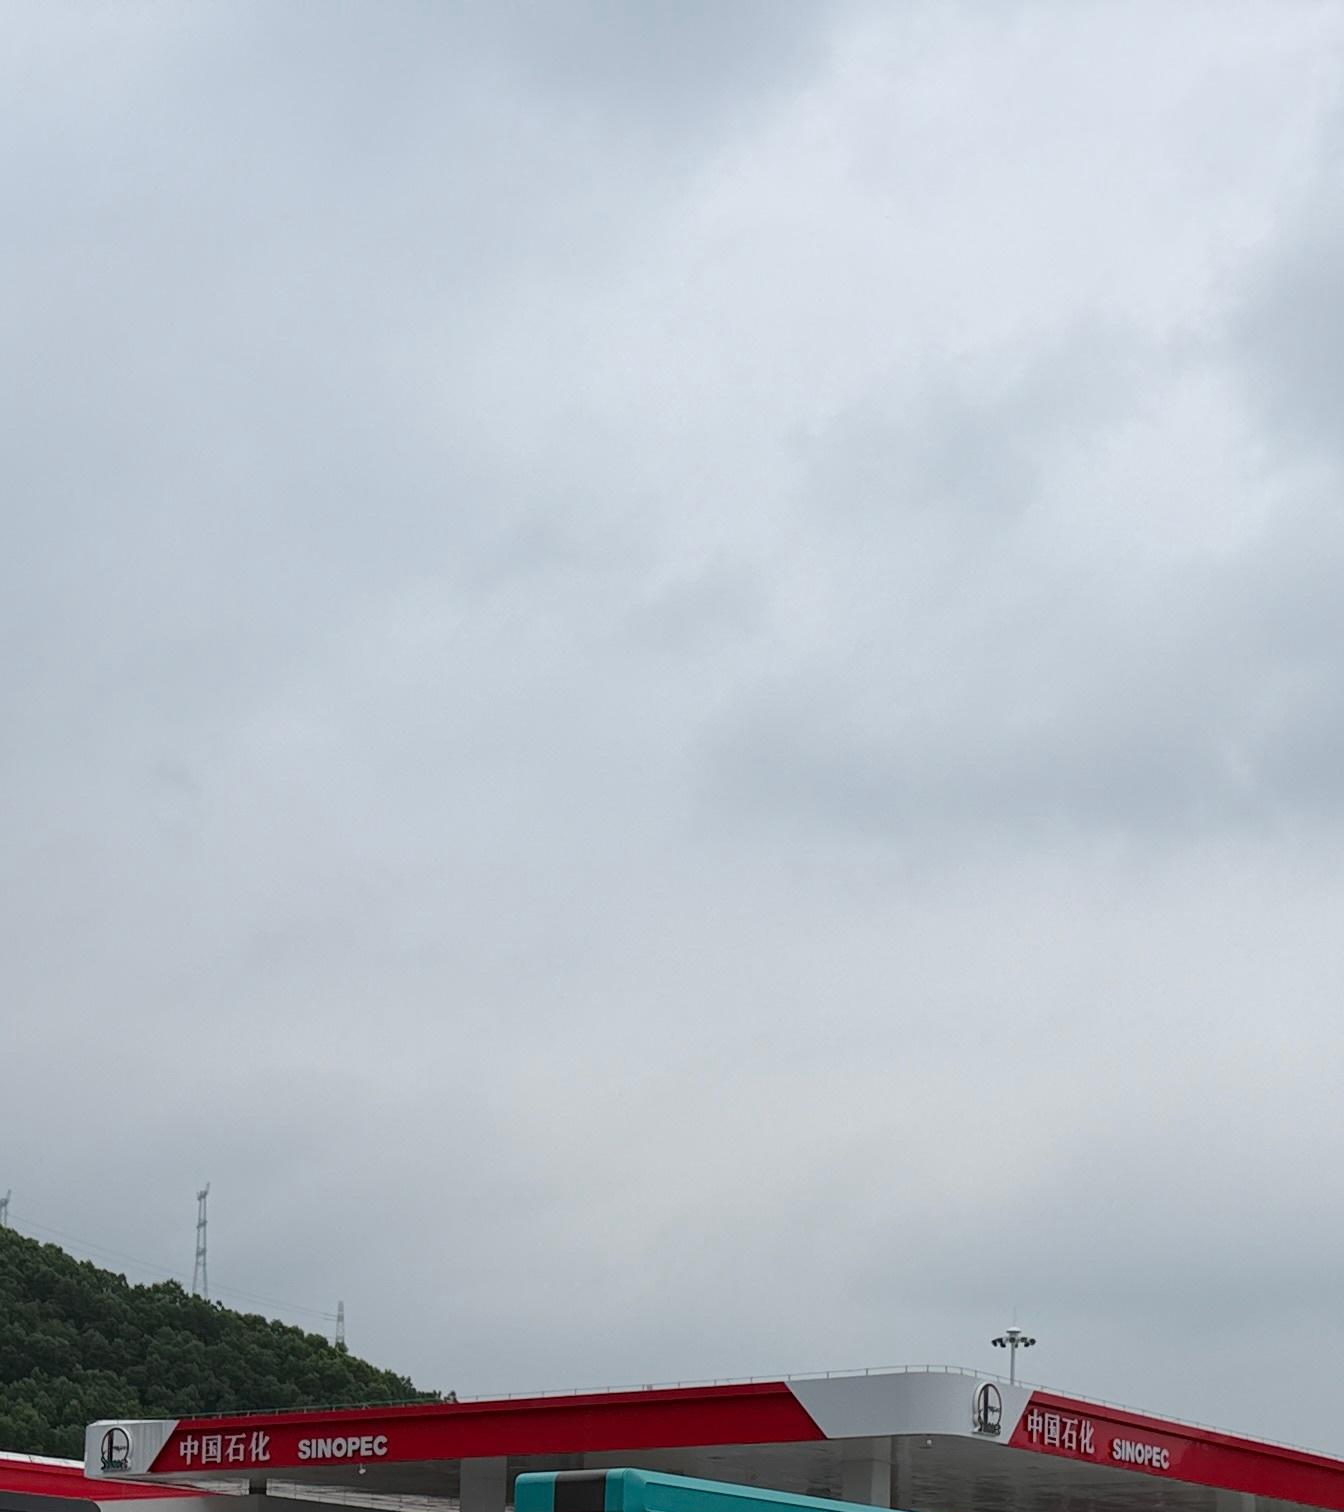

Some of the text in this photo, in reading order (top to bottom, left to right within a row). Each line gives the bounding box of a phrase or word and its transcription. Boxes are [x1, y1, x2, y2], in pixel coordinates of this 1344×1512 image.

[179, 1431, 271, 1465] 中国石化
[297, 1435, 388, 1460] SINOPEC
[1027, 1408, 1095, 1455] 中国石化
[1112, 1438, 1170, 1470] SINOPEC
